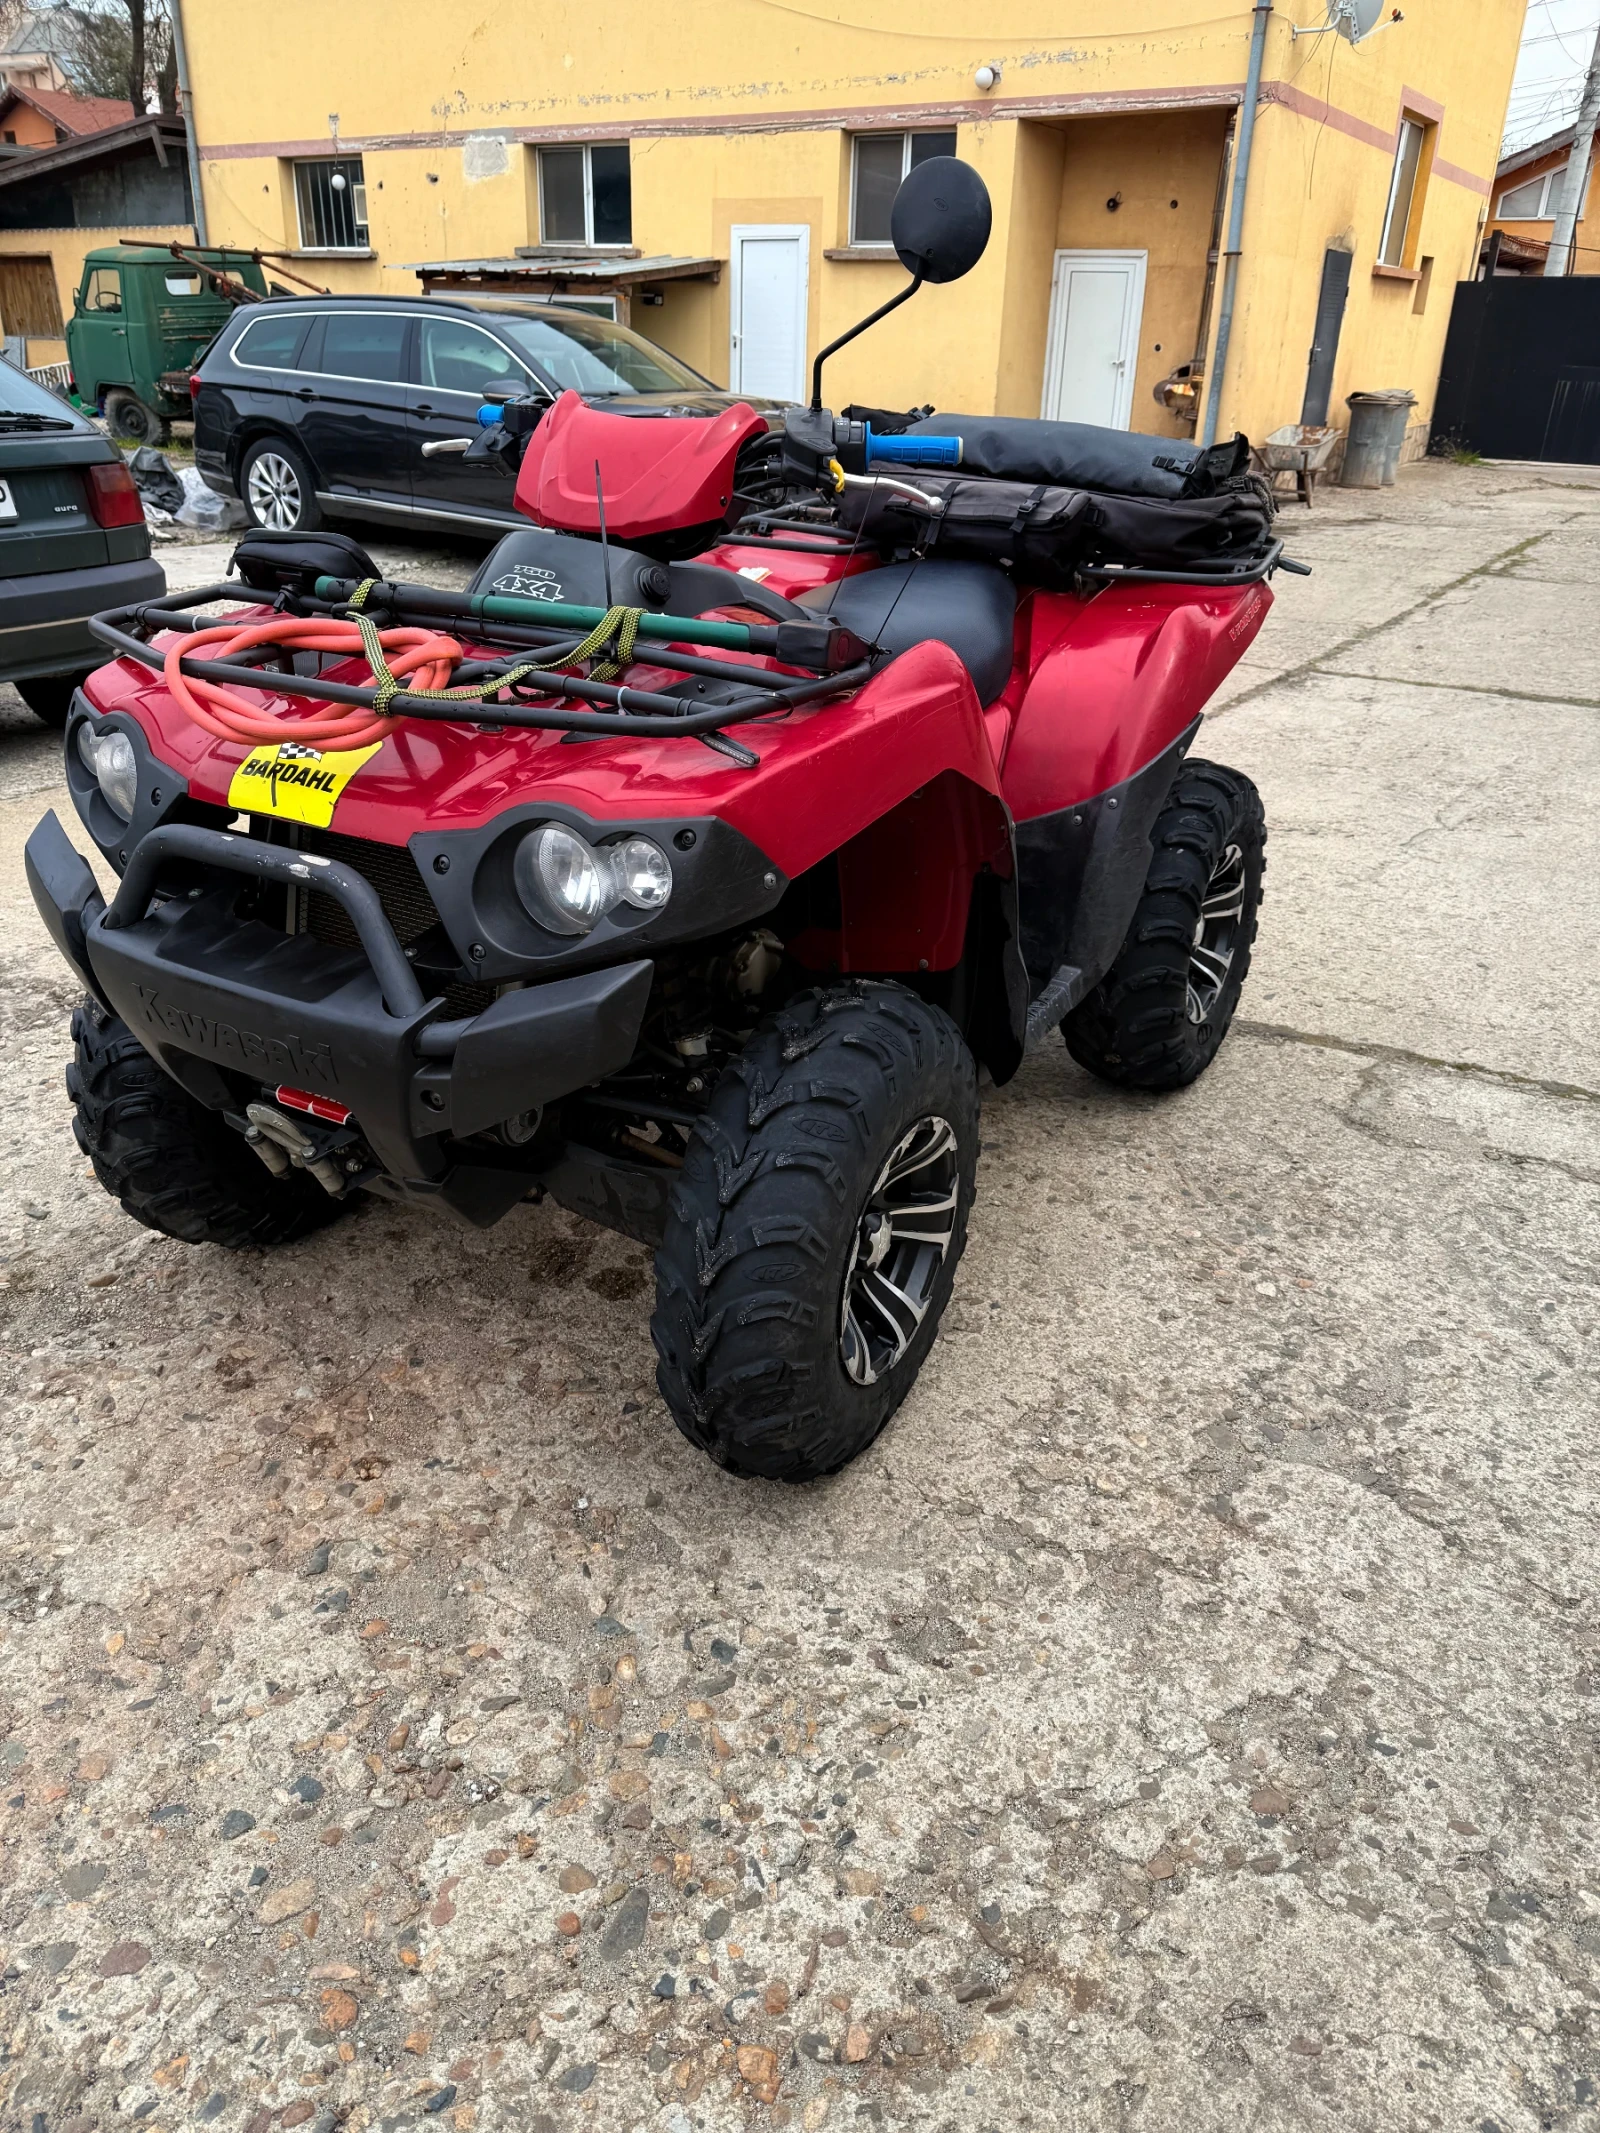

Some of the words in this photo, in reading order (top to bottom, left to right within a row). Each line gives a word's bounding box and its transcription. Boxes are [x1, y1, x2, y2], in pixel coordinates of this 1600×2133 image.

[53, 504, 79, 513] aura
[513, 564, 557, 580] 750
[241, 758, 337, 794] BARDAHL
[131, 982, 340, 1085] Kawasaki
[806, 1120, 846, 1139] ITP
[757, 1264, 797, 1281] ITP
